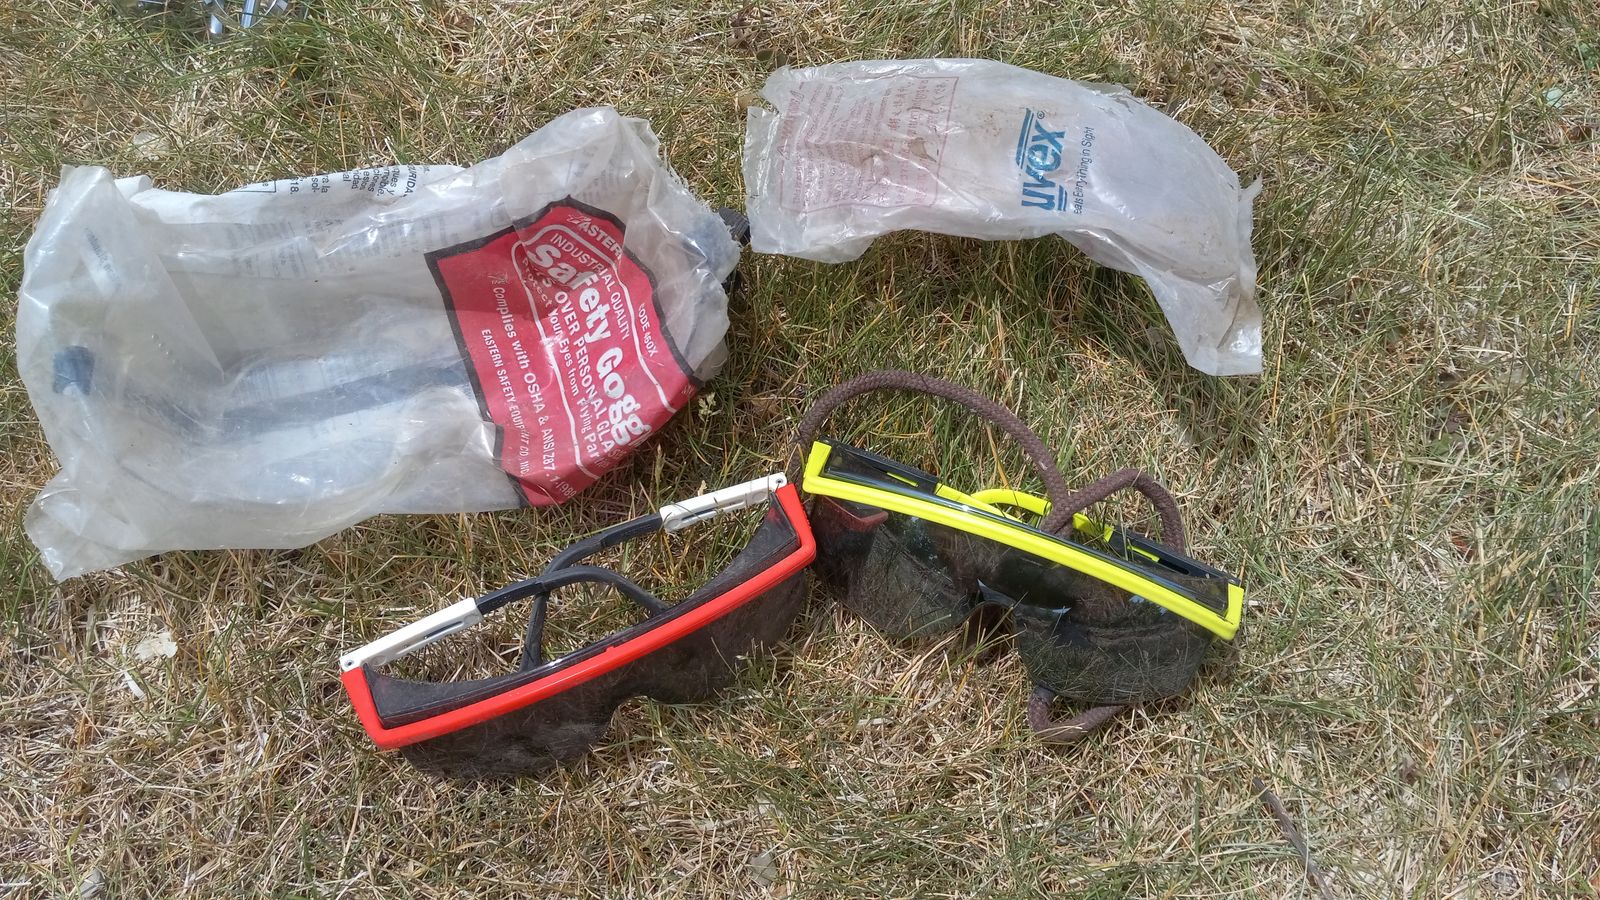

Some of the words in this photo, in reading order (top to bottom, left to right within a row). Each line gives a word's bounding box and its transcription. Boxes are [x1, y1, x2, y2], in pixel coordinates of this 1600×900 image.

[1021, 119, 1066, 211] uvex
[1081, 126, 1096, 147] Sight
[1081, 148, 1091, 159] in
[526, 244, 612, 343] Safety
[550, 233, 616, 292] INDUSTRIAL
[610, 291, 631, 340] QUALITY
[481, 328, 504, 368] EASTERN
[496, 369, 517, 402] SAFETY
[492, 287, 517, 338] Complies
[511, 340, 529, 369] with
[524, 372, 546, 414] OSHA
[538, 415, 550, 426] &
[554, 290, 581, 335] OVER
[573, 336, 608, 419] PERSONAL
[559, 337, 574, 368] Eyes
[567, 367, 580, 397] from
[576, 396, 594, 434] Flying
